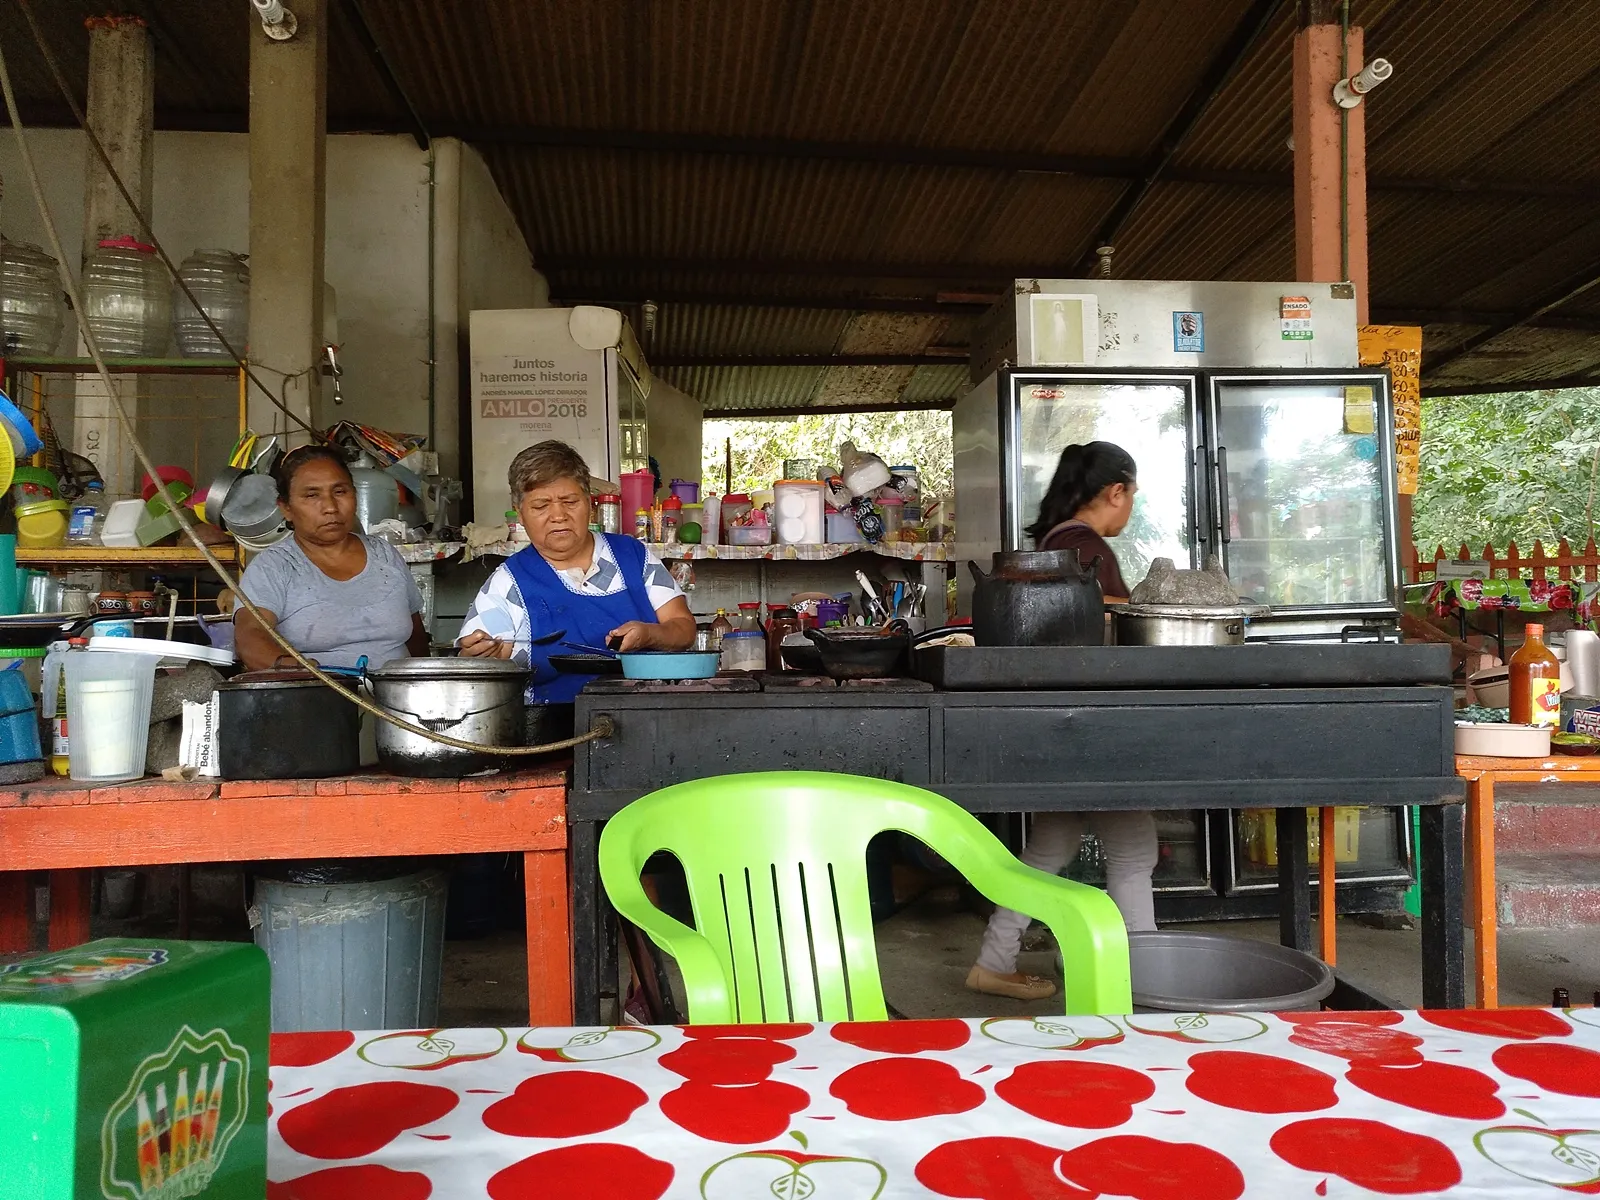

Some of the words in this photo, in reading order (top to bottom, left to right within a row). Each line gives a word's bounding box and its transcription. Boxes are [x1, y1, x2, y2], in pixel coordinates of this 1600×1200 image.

[512, 358, 555, 369] Juntos
[480, 372, 537, 382] haremos
[540, 371, 588, 382] historia
[482, 400, 544, 417] AMLO
[547, 403, 588, 418] 2018
[200, 743, 210, 768] Bebé
